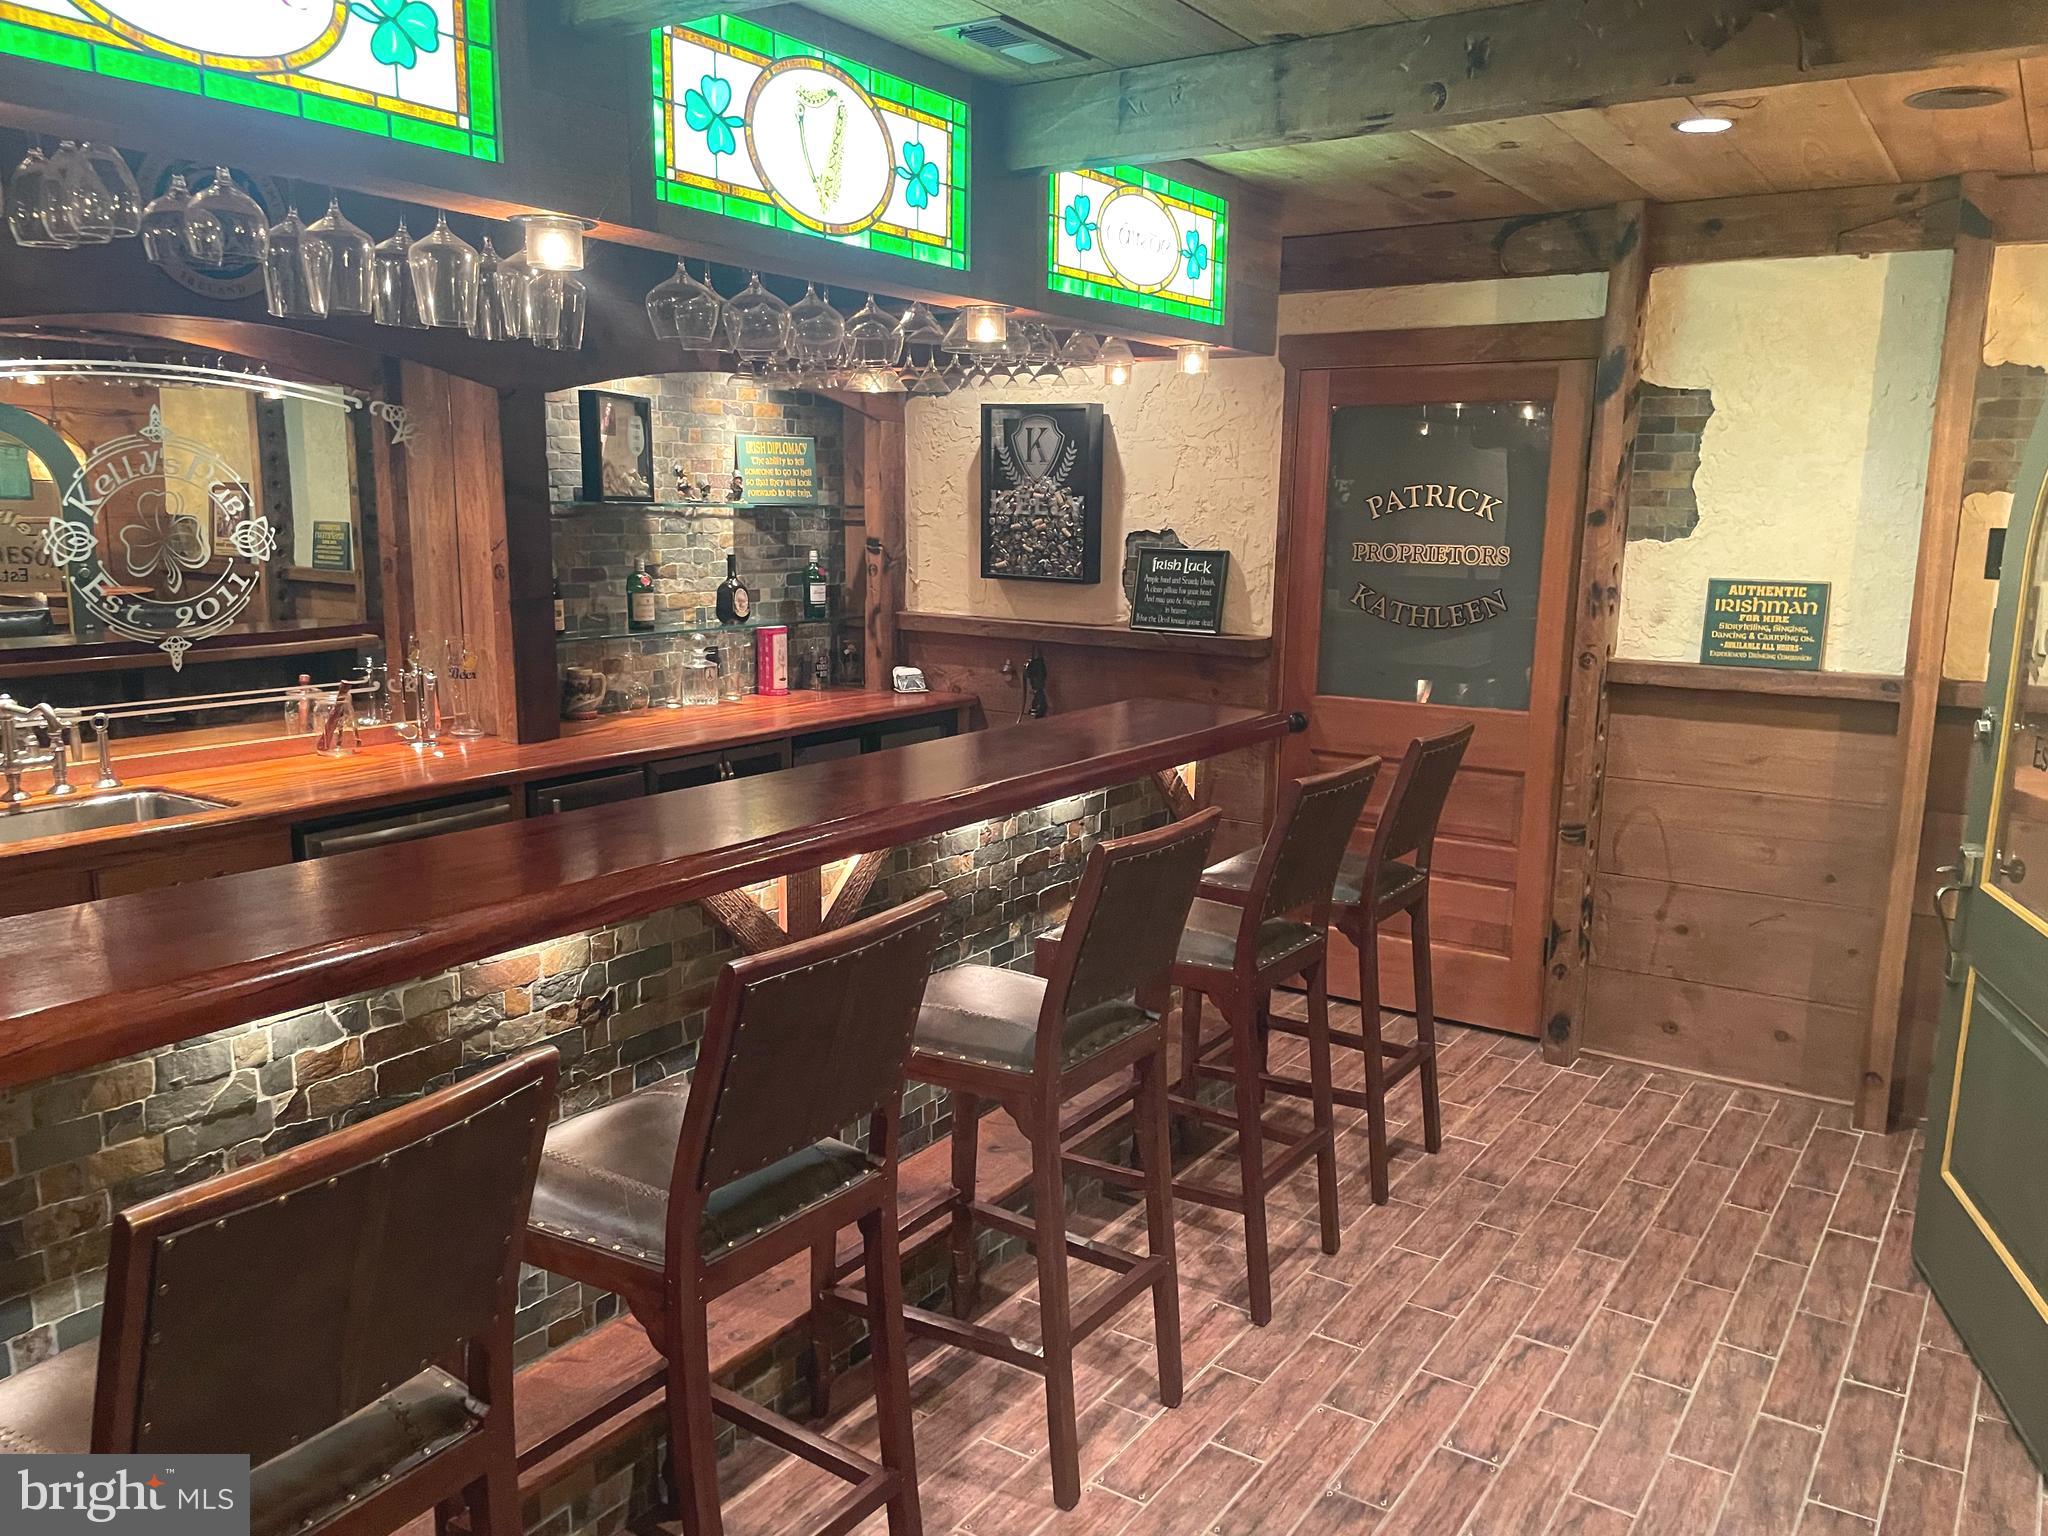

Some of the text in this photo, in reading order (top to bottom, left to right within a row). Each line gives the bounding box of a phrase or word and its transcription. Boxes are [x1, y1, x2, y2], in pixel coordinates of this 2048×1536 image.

[745, 441, 807, 455] IRISH DIPLOMACY
[1024, 427, 1048, 463] K
[787, 458, 794, 466] to
[775, 468, 782, 476] to
[1366, 484, 1503, 522] PATRICK
[1352, 542, 1511, 566] PROPRIETORS
[1184, 558, 1212, 574] Luck
[1144, 584, 1149, 592] A
[1728, 585, 1808, 598] AUTHENTIC
[175, 571, 250, 629] 2011
[1350, 581, 1508, 629] KATHLEEN
[1739, 614, 1790, 623] FOR HIRE
[1748, 632, 1754, 640] &
[1762, 643, 1775, 651] ALL
